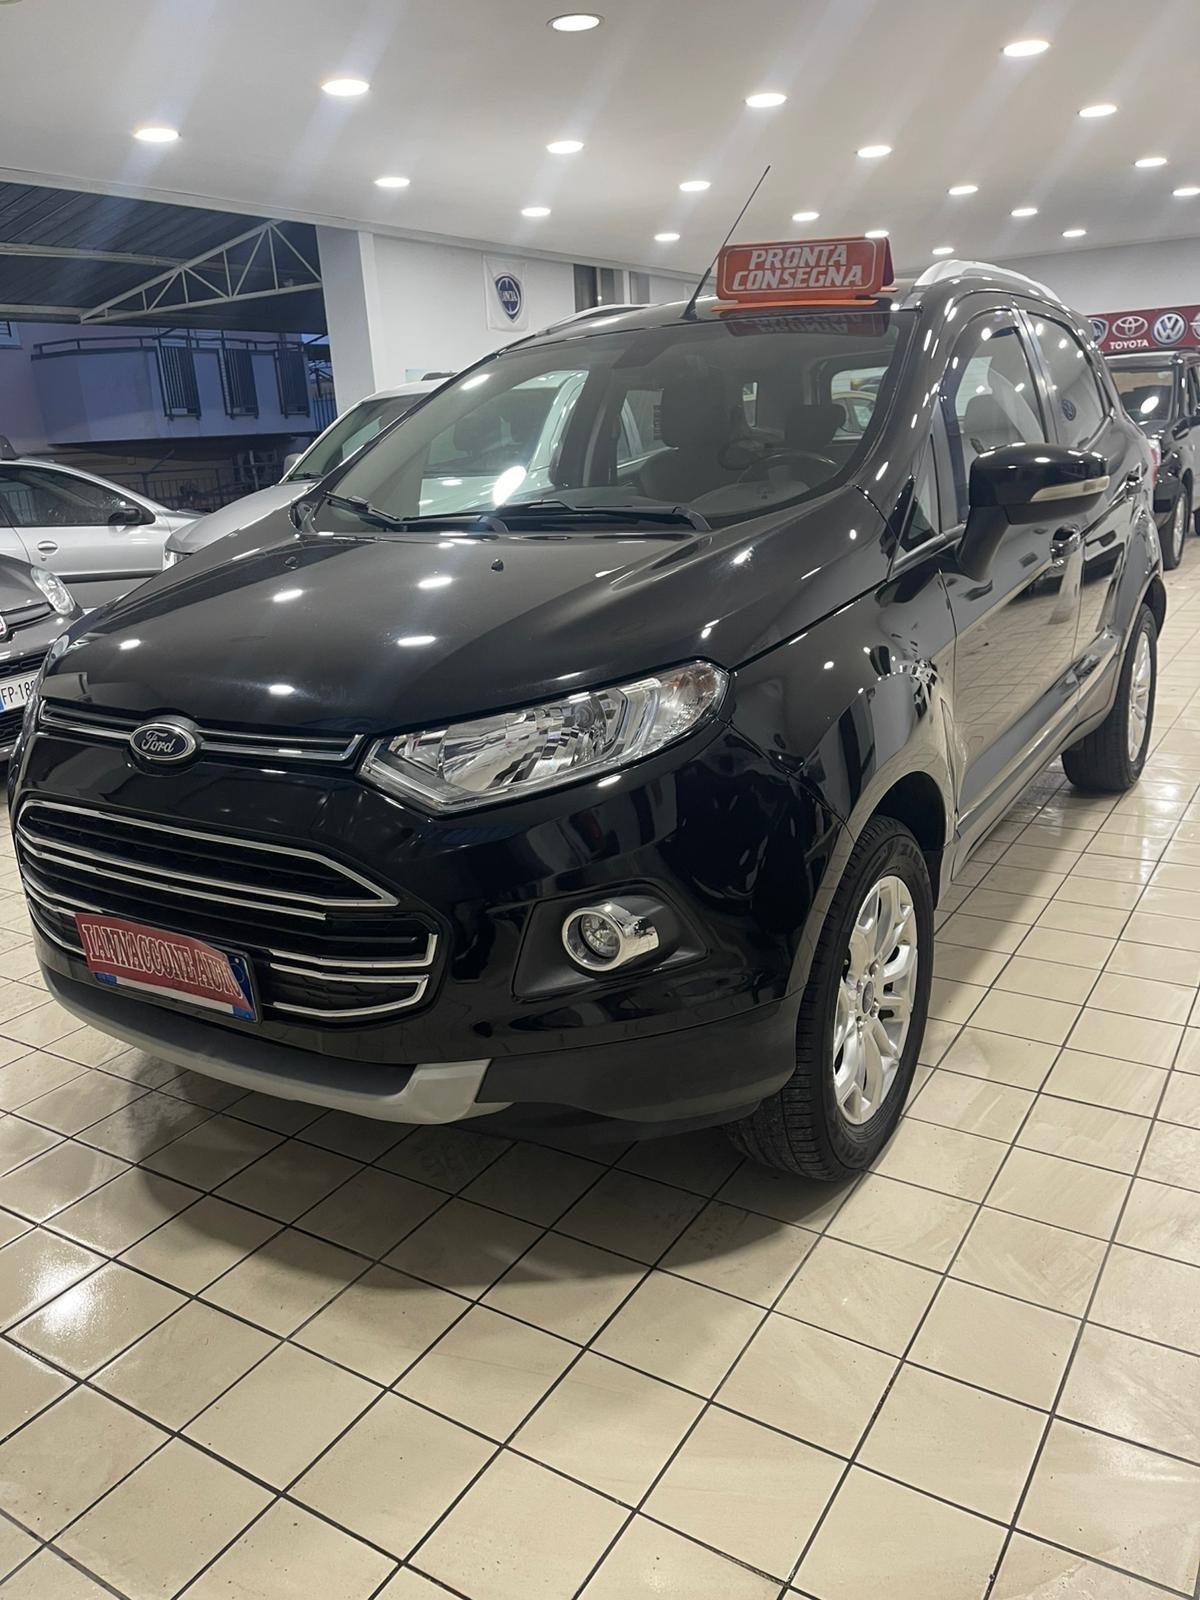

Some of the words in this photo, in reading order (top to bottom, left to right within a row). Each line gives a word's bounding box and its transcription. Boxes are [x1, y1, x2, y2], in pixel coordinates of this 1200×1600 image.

[749, 245, 847, 269] PRONTA
[732, 265, 862, 290] CONSEGNA
[1109, 339, 1149, 350] TOYOTA
[141, 730, 176, 753] Ford
